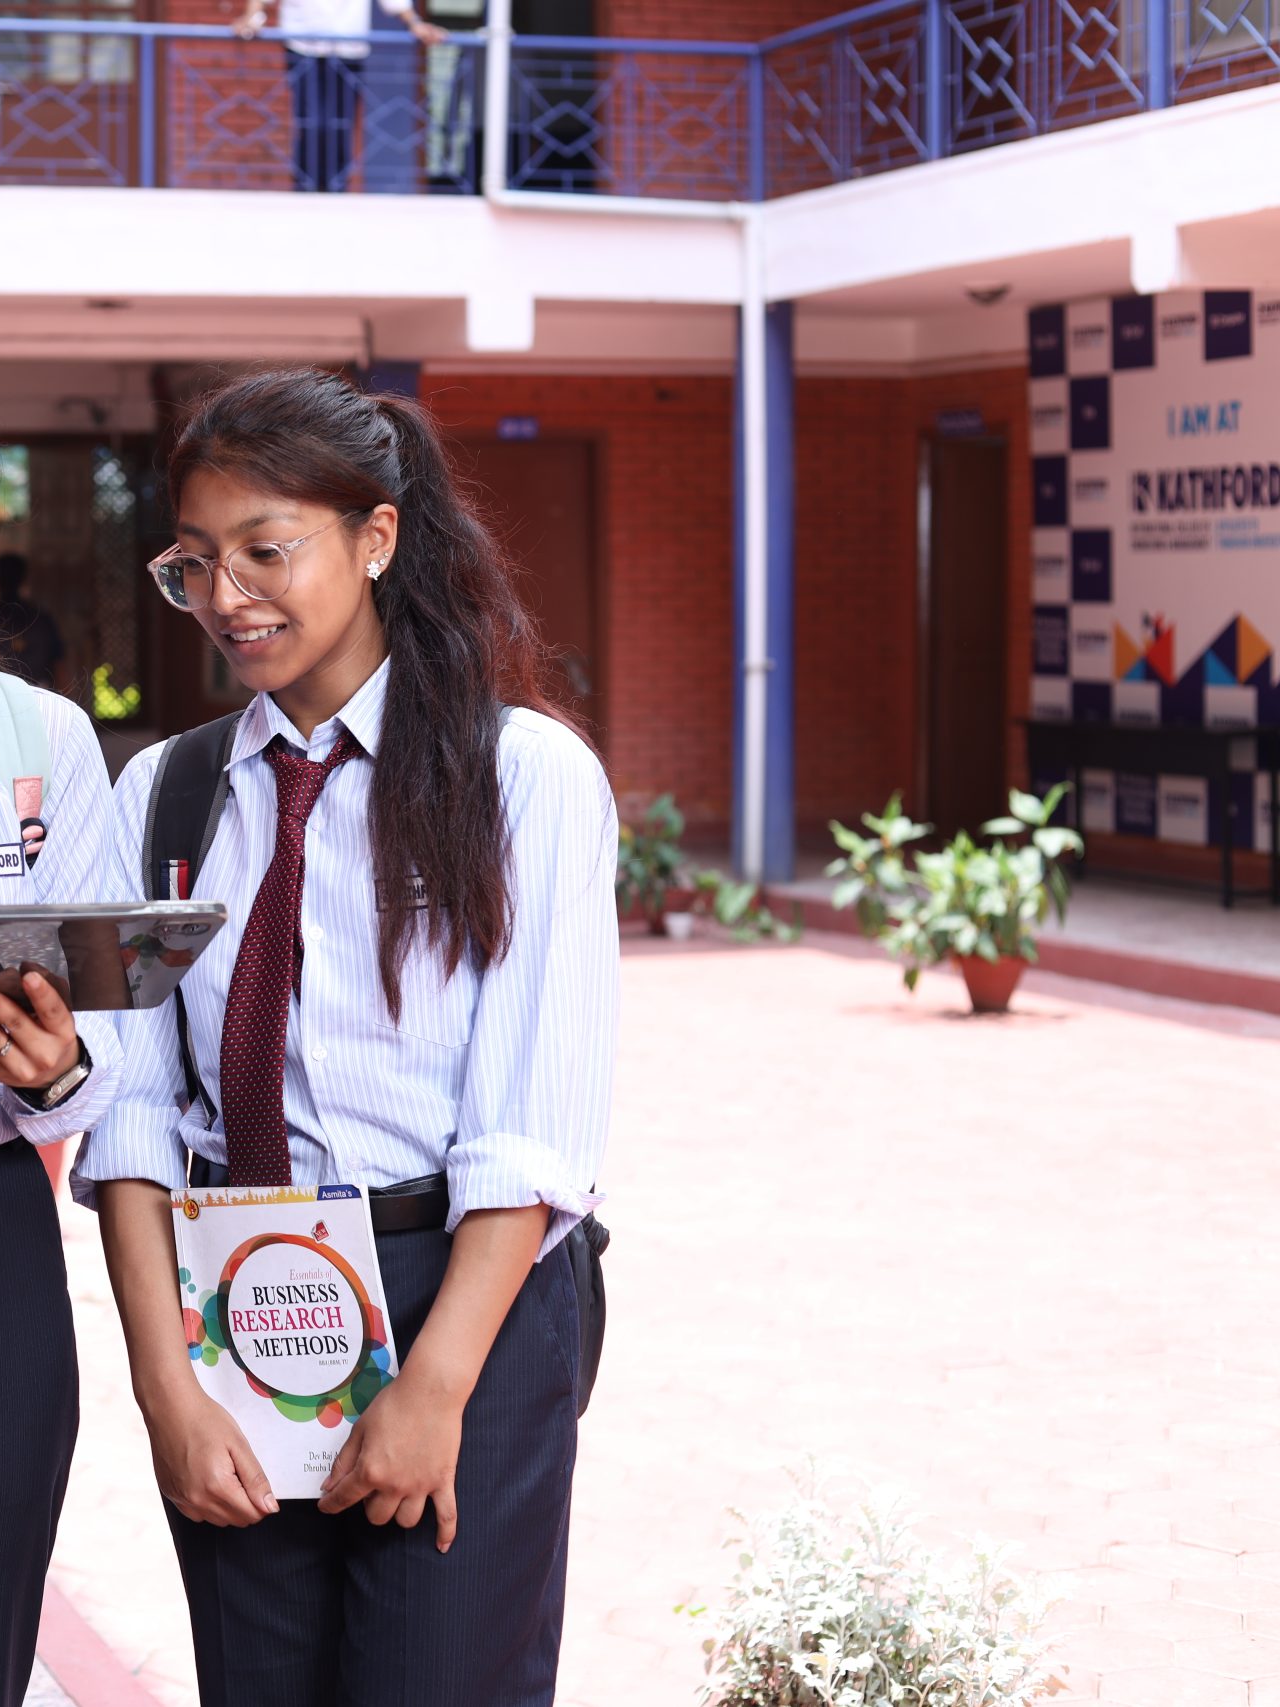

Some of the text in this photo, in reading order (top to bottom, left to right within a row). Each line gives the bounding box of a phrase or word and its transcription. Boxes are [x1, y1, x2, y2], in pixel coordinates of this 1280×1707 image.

[1181, 406, 1211, 434] AM
[1217, 401, 1240, 431] AT
[1157, 463, 1280, 512] KATHFORD
[321, 1189, 353, 1199] Asmita's
[289, 1269, 323, 1281] Essentials
[252, 1283, 339, 1306] BUSINESS
[231, 1306, 344, 1333] RESEARCH
[253, 1334, 349, 1358] METHODS
[322, 1451, 333, 1461] Raj
